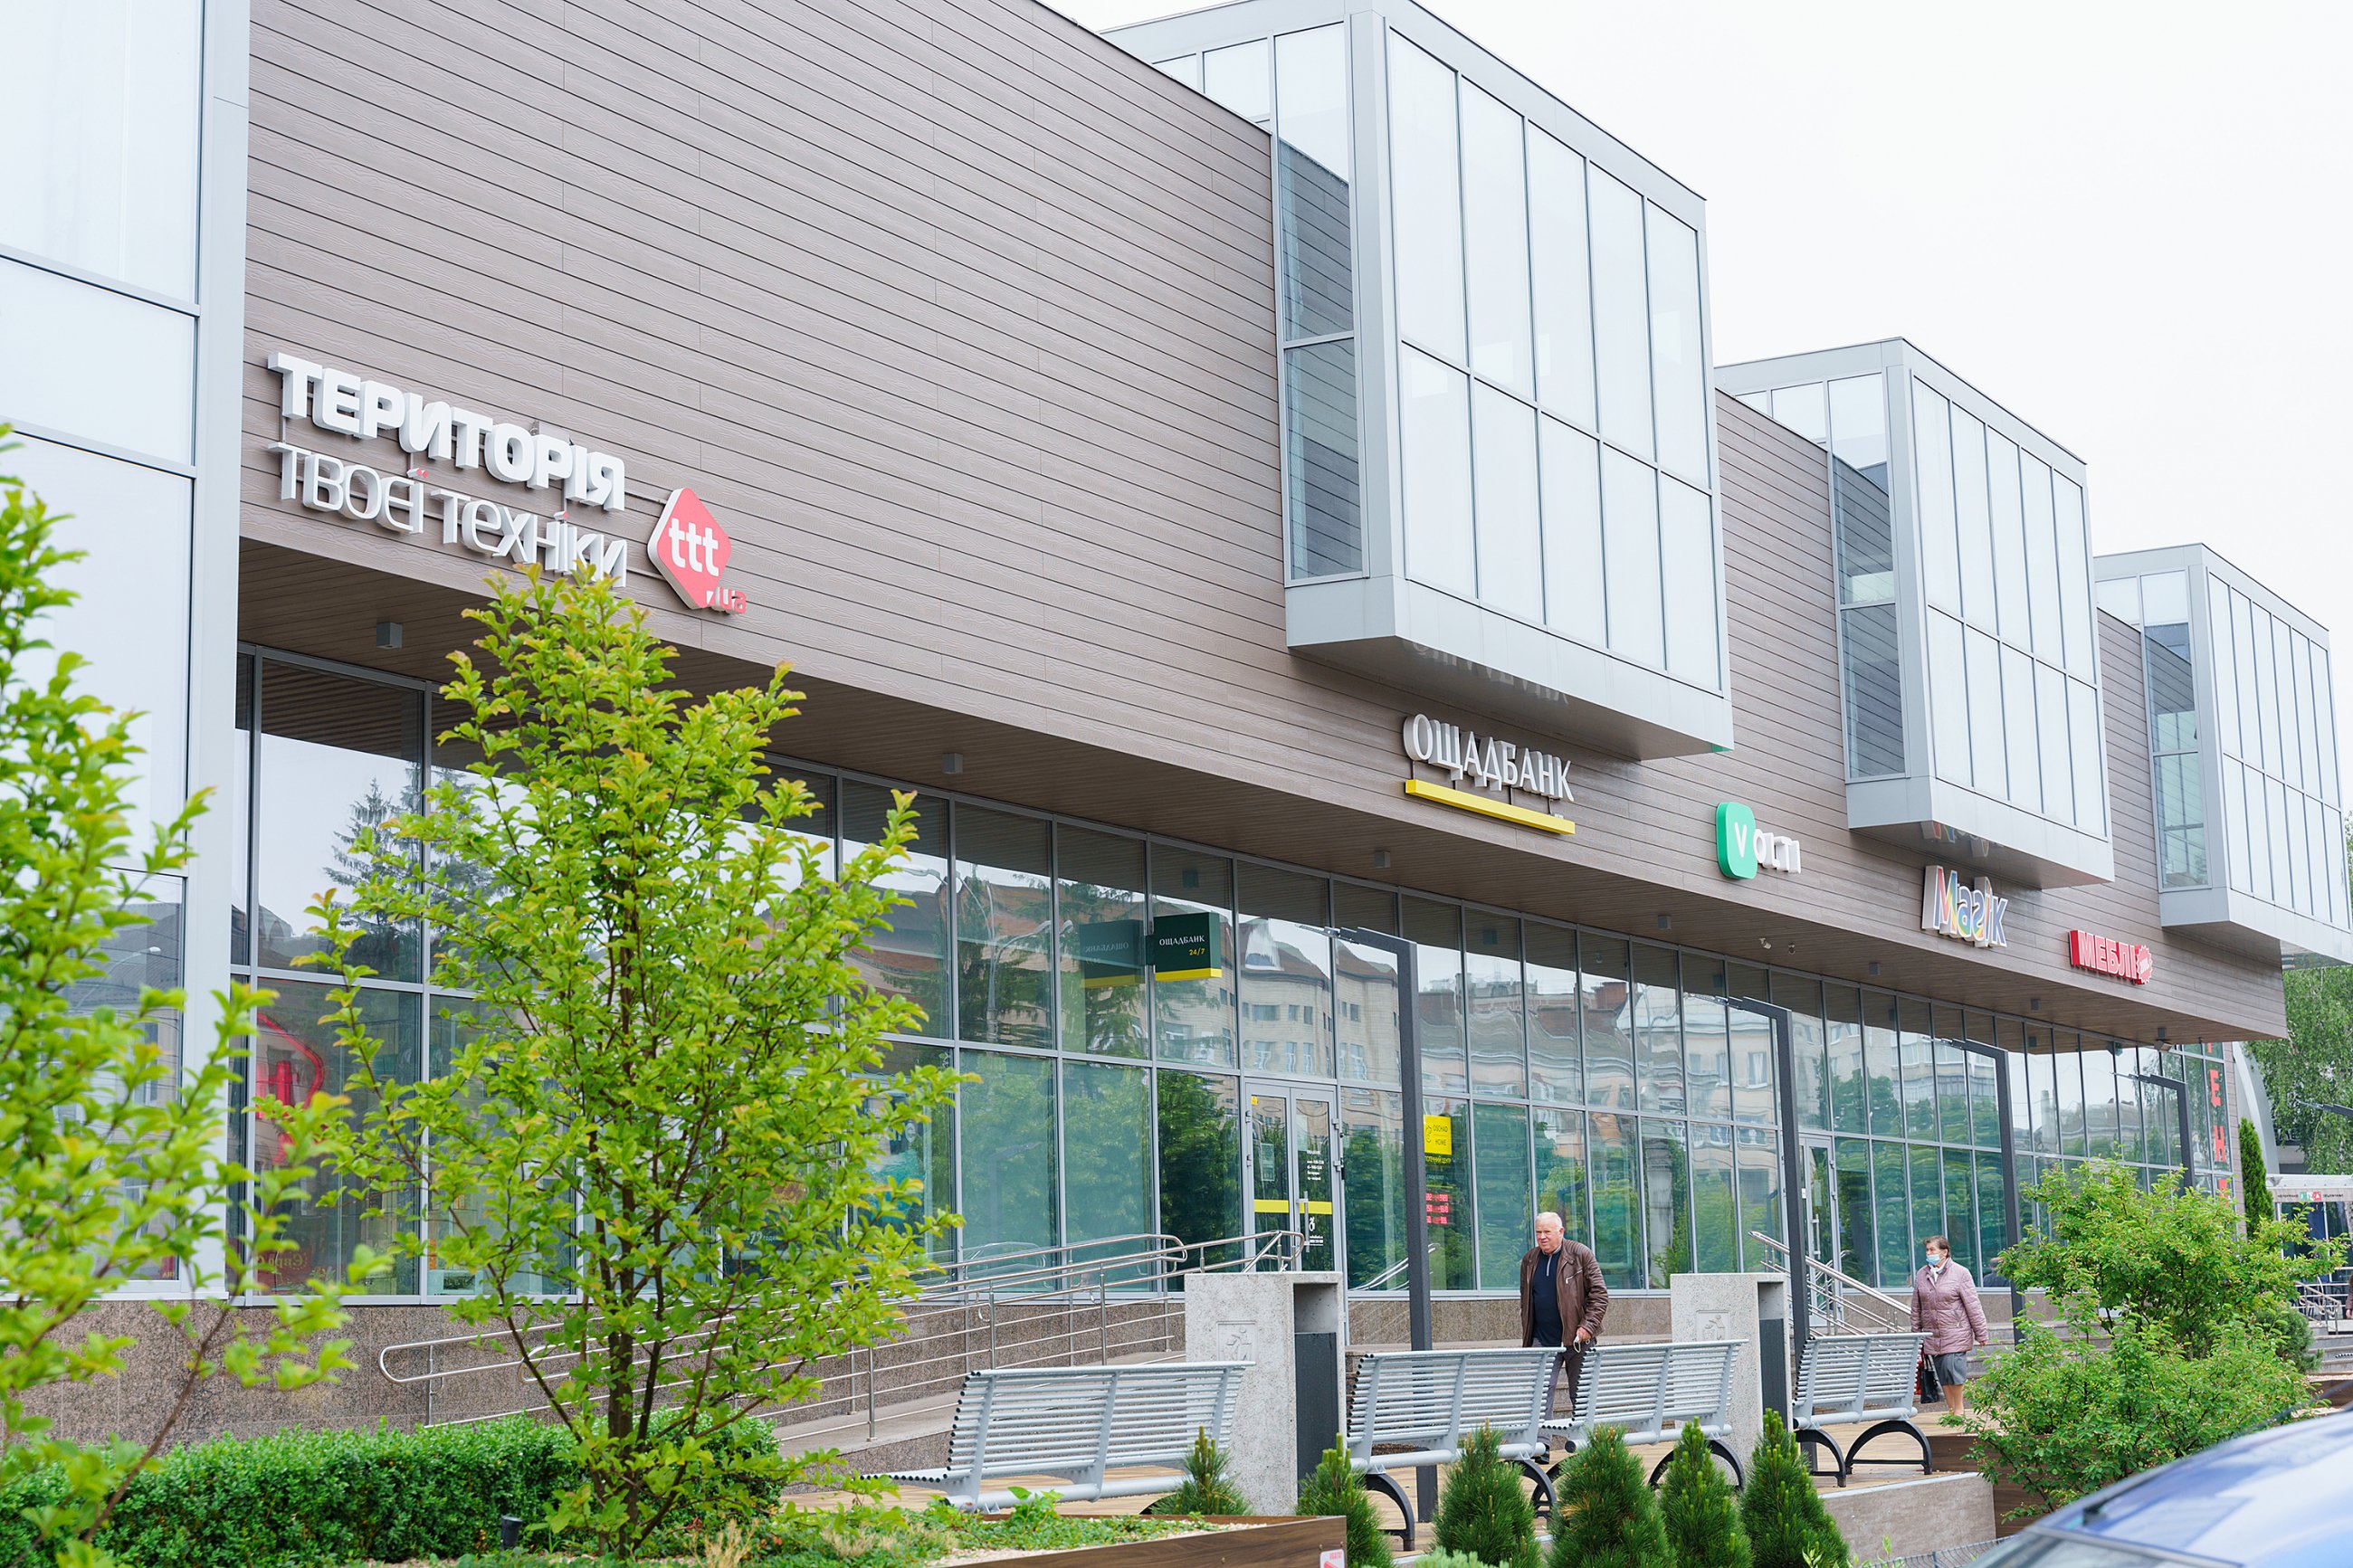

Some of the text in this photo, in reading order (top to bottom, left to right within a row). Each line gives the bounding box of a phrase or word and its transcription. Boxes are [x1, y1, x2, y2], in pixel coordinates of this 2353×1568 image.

[268, 352, 625, 512] ТЕРИТОРІЯ
[668, 518, 720, 577] ttt
[1403, 713, 1576, 803] ОЩАДБАНК
[1158, 935, 1205, 946] ОЩАДБАНК
[1188, 947, 1205, 956] 24/7
[2069, 929, 2139, 981] МЕБЛІ
